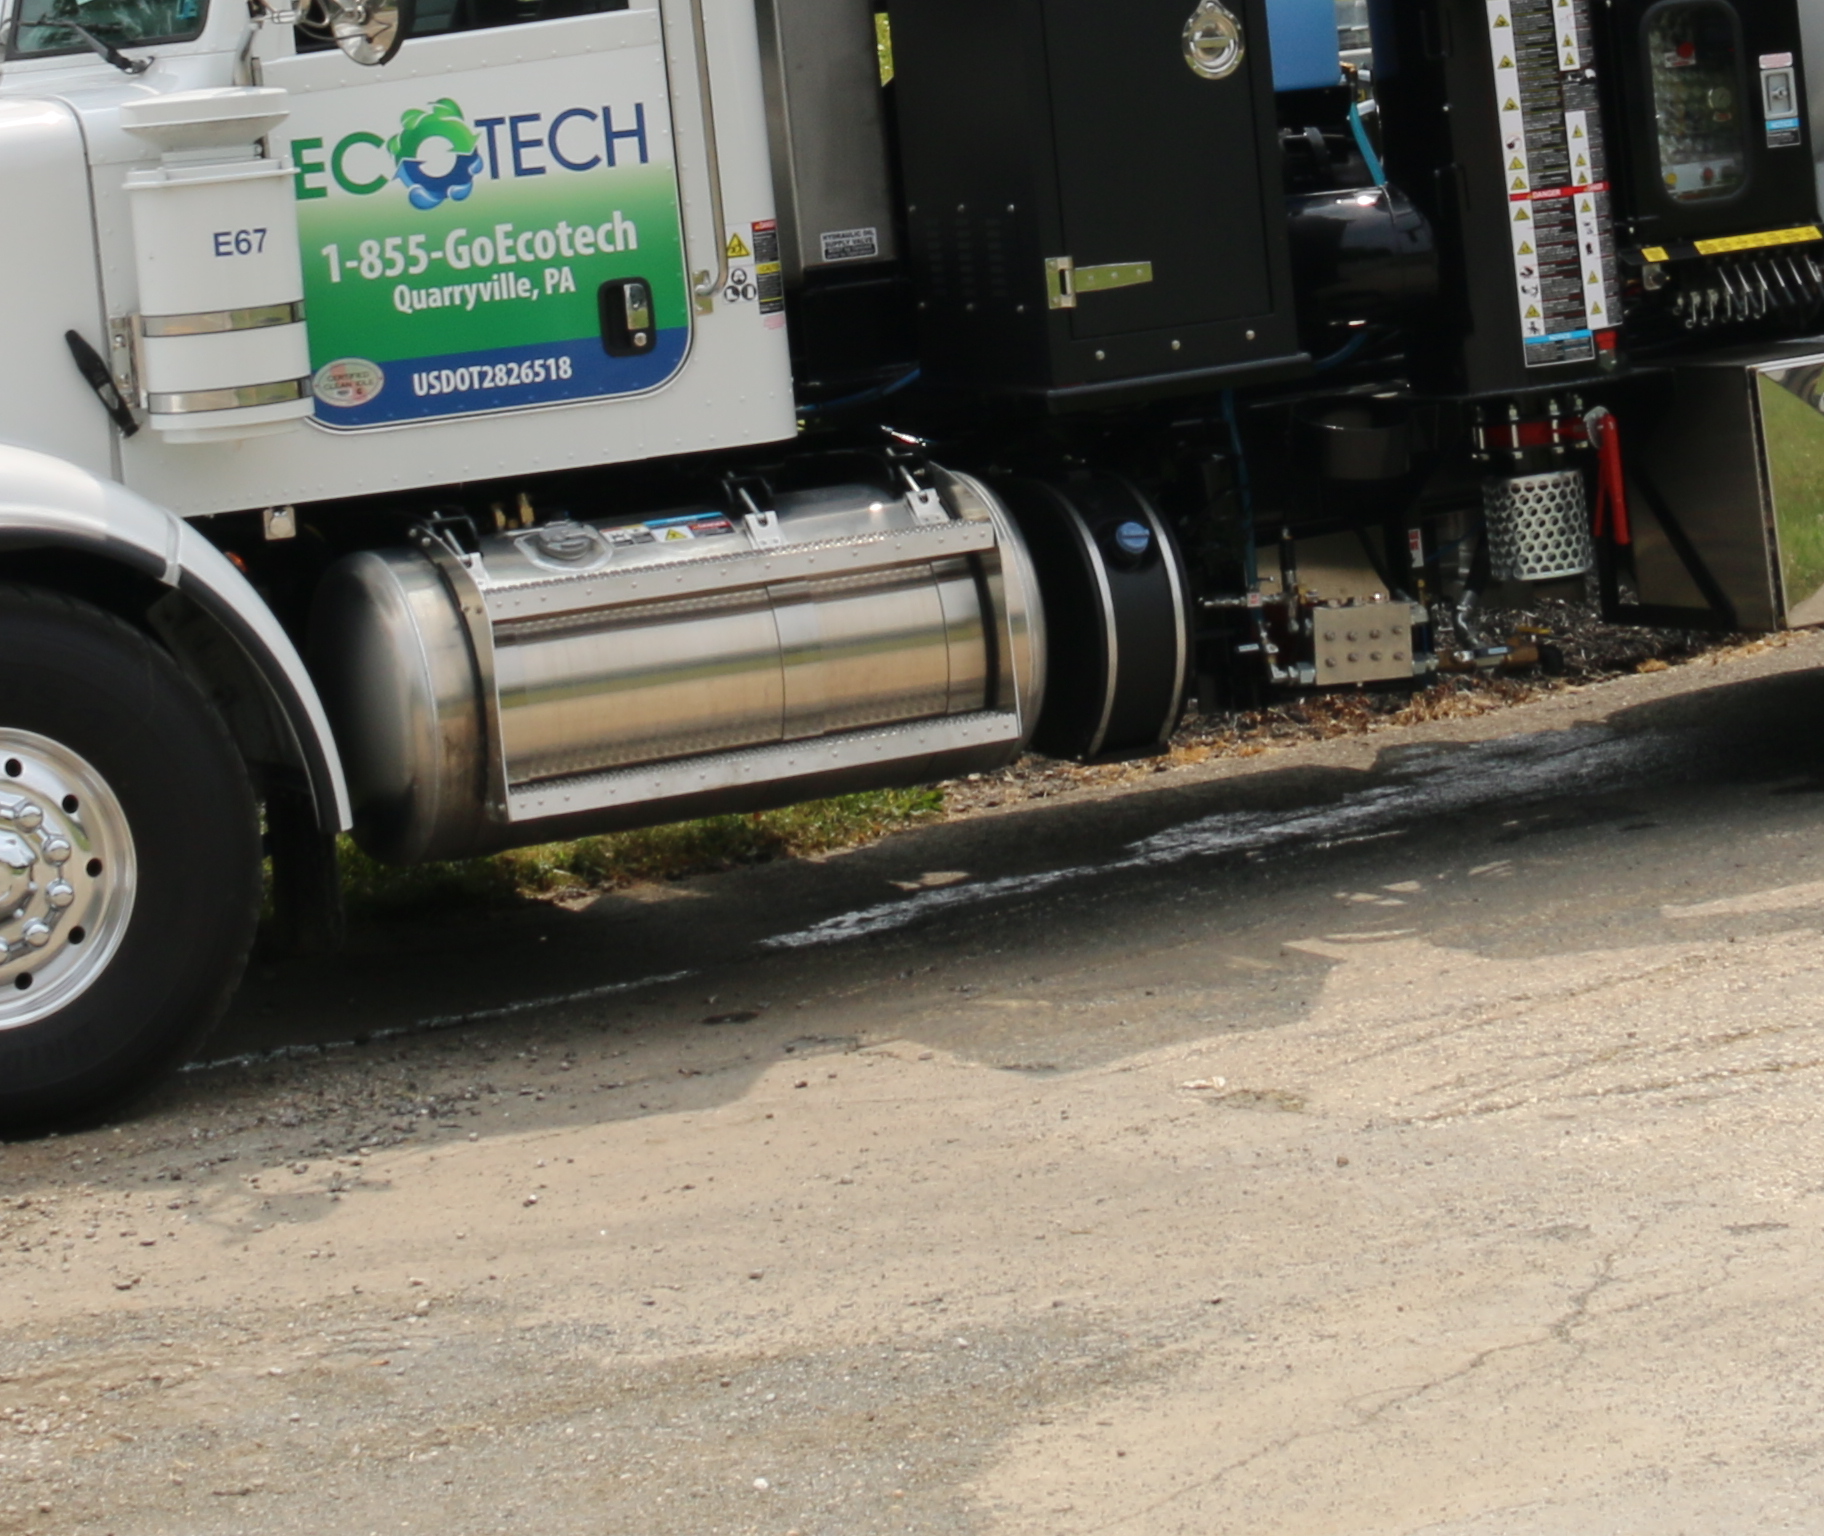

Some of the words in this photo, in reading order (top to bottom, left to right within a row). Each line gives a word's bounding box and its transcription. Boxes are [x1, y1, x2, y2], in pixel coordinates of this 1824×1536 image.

[214, 228, 268, 257] E67
[321, 211, 637, 282] 1-855-GoEcotech
[393, 271, 539, 314] Quarryville,
[544, 267, 576, 295] PA
[413, 357, 573, 396] USDOT2826518
